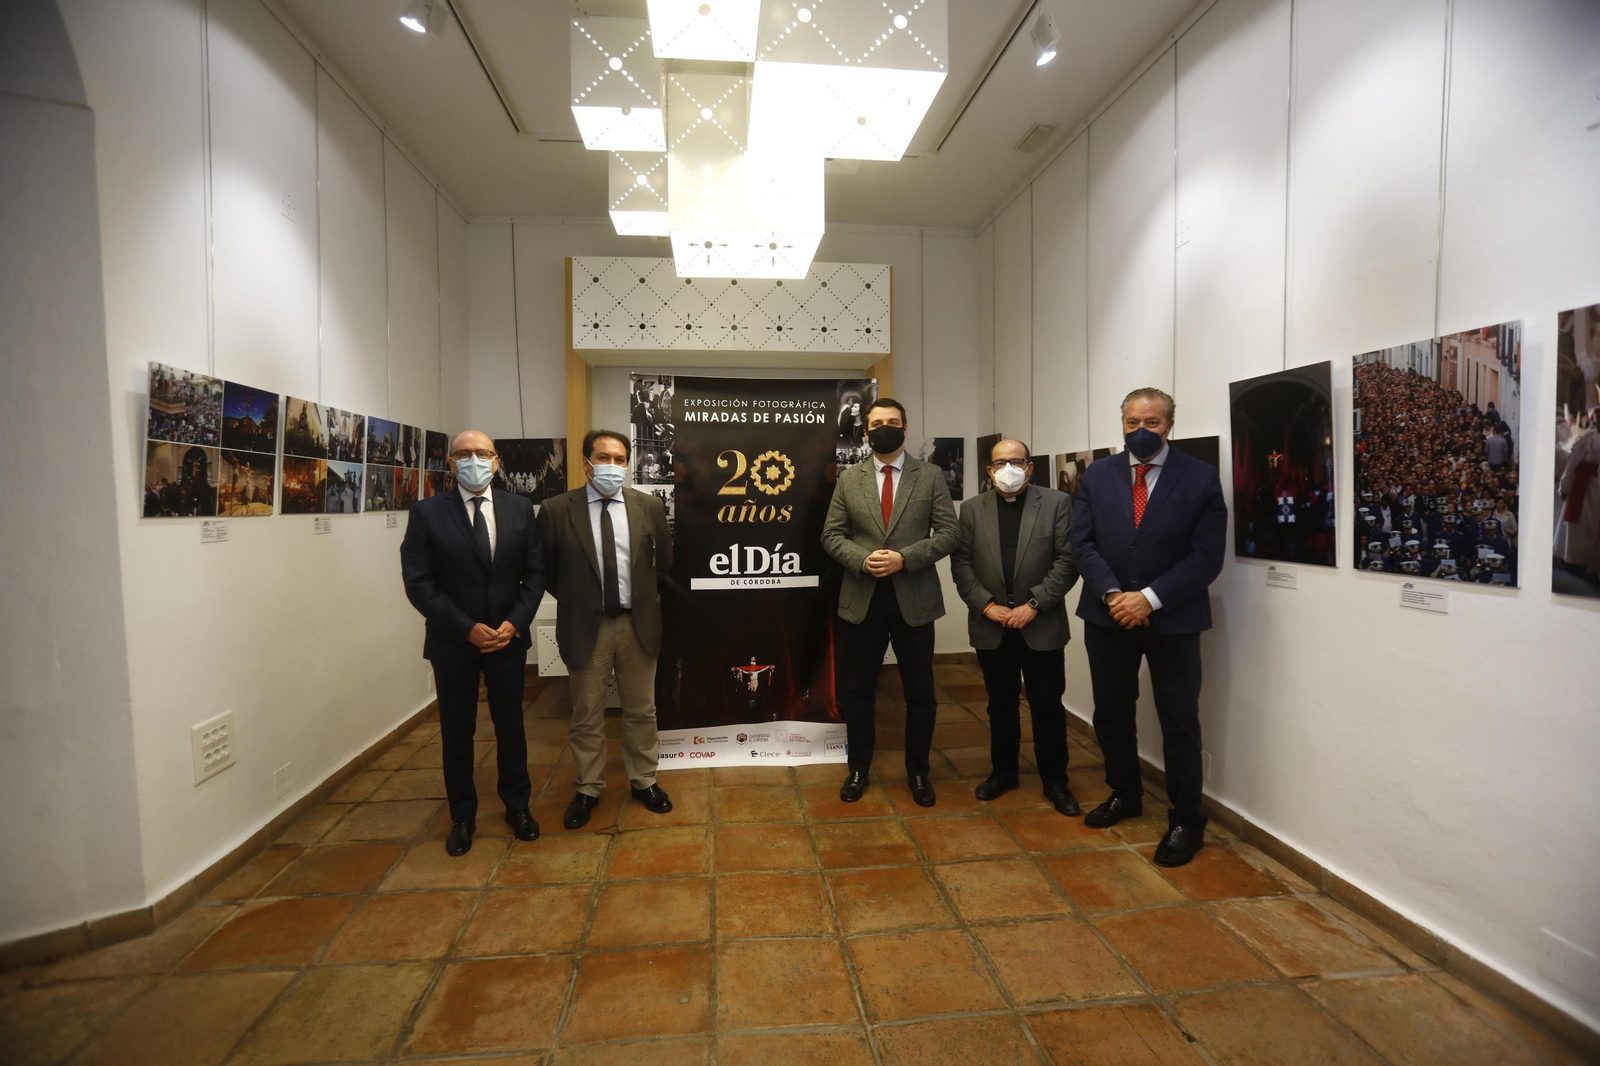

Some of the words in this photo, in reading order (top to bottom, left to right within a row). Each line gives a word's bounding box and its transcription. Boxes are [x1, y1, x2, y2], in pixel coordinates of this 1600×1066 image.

[684, 398, 748, 408] EXPOSICIÓN
[753, 399, 826, 409] FOTOGRÁFICA
[684, 411, 748, 423] MIRADAS
[753, 412, 770, 423] DE
[775, 410, 825, 424] PASIÓN
[717, 499, 793, 523] años
[709, 543, 741, 575] el
[743, 543, 802, 575] Día
[743, 578, 782, 586] CÓRDOBA
